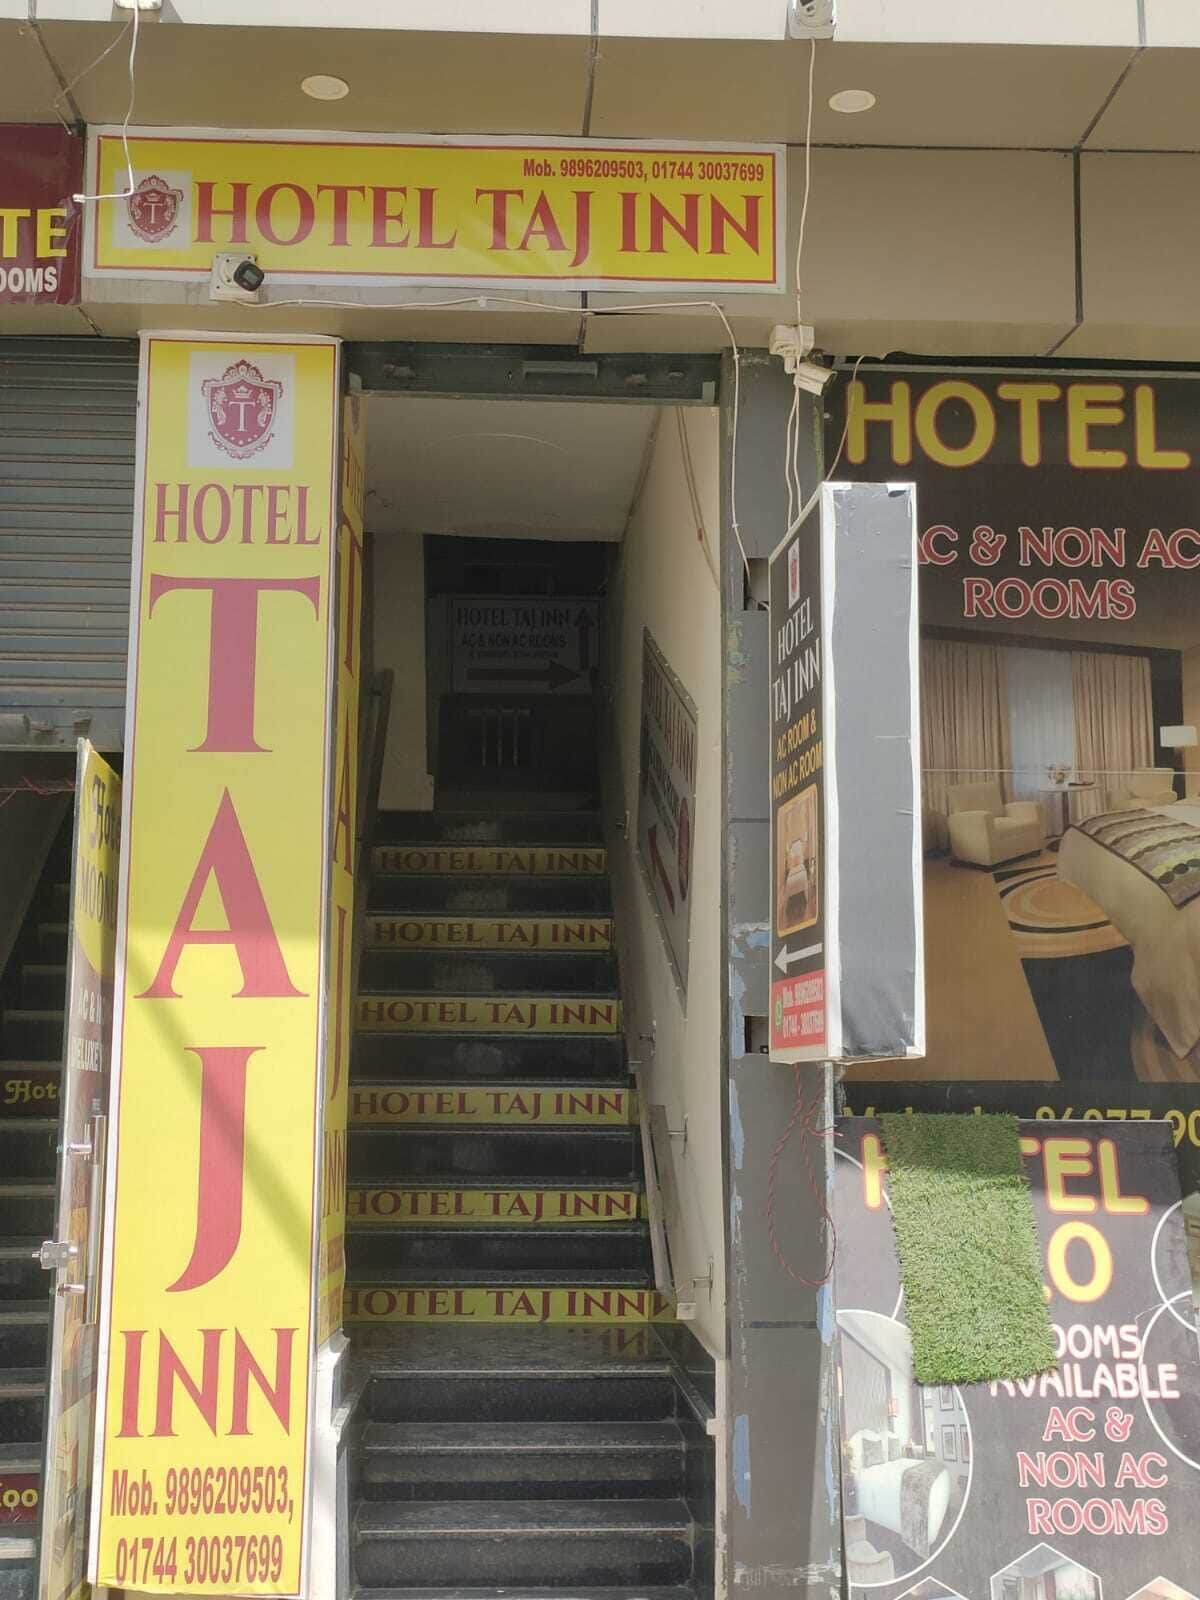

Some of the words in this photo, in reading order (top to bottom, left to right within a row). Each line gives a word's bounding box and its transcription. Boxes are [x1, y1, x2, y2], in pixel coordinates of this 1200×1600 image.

[524, 158, 556, 178] Mob.
[560, 159, 648, 182] 9896209503,
[652, 161, 694, 180] 01744
[698, 161, 765, 181] 30037699
[193, 181, 458, 249] HOTEL
[475, 188, 596, 268] TAJ
[617, 190, 765, 257] INN
[846, 379, 1191, 469] HOTEL
[153, 482, 322, 546] HOTEL
[969, 525, 1006, 567] &
[1018, 527, 1126, 568] NON
[1137, 528, 1200, 569] AC
[963, 577, 1137, 620] ROOMS
[777, 596, 814, 665] HOTEL
[772, 667, 791, 722] TAJ
[795, 637, 821, 705] INN
[381, 851, 484, 871] HOTEL
[489, 851, 536, 873] TAJ
[547, 853, 601, 872] INN
[374, 921, 485, 943] HOTEL
[491, 923, 540, 947] TAJ
[552, 923, 610, 944] INN
[361, 1001, 477, 1023] HOTEL
[486, 1002, 538, 1029] TAJ
[551, 1003, 614, 1025] INN
[352, 1091, 477, 1115] HOTEL
[486, 1092, 542, 1121] TAJ
[555, 1093, 624, 1115] INN
[346, 1191, 475, 1216] HOTEL
[484, 1192, 545, 1223] TAJ
[559, 1193, 632, 1217] INN
[486, 1290, 552, 1322] TAJ
[567, 1291, 646, 1317] INN
[1050, 1324, 1142, 1359] OOMS
[114, 1326, 300, 1438] INN
[1042, 1406, 1095, 1441] AC
[1104, 1406, 1134, 1441] &
[1016, 1452, 1106, 1488] NON
[1116, 1452, 1168, 1488] AC
[110, 1468, 158, 1517] Mob.
[165, 1465, 294, 1525] 9896209503,
[1026, 1499, 1168, 1535] ROOMS
[116, 1536, 178, 1586] 01744
[183, 1534, 284, 1585] 30037699
